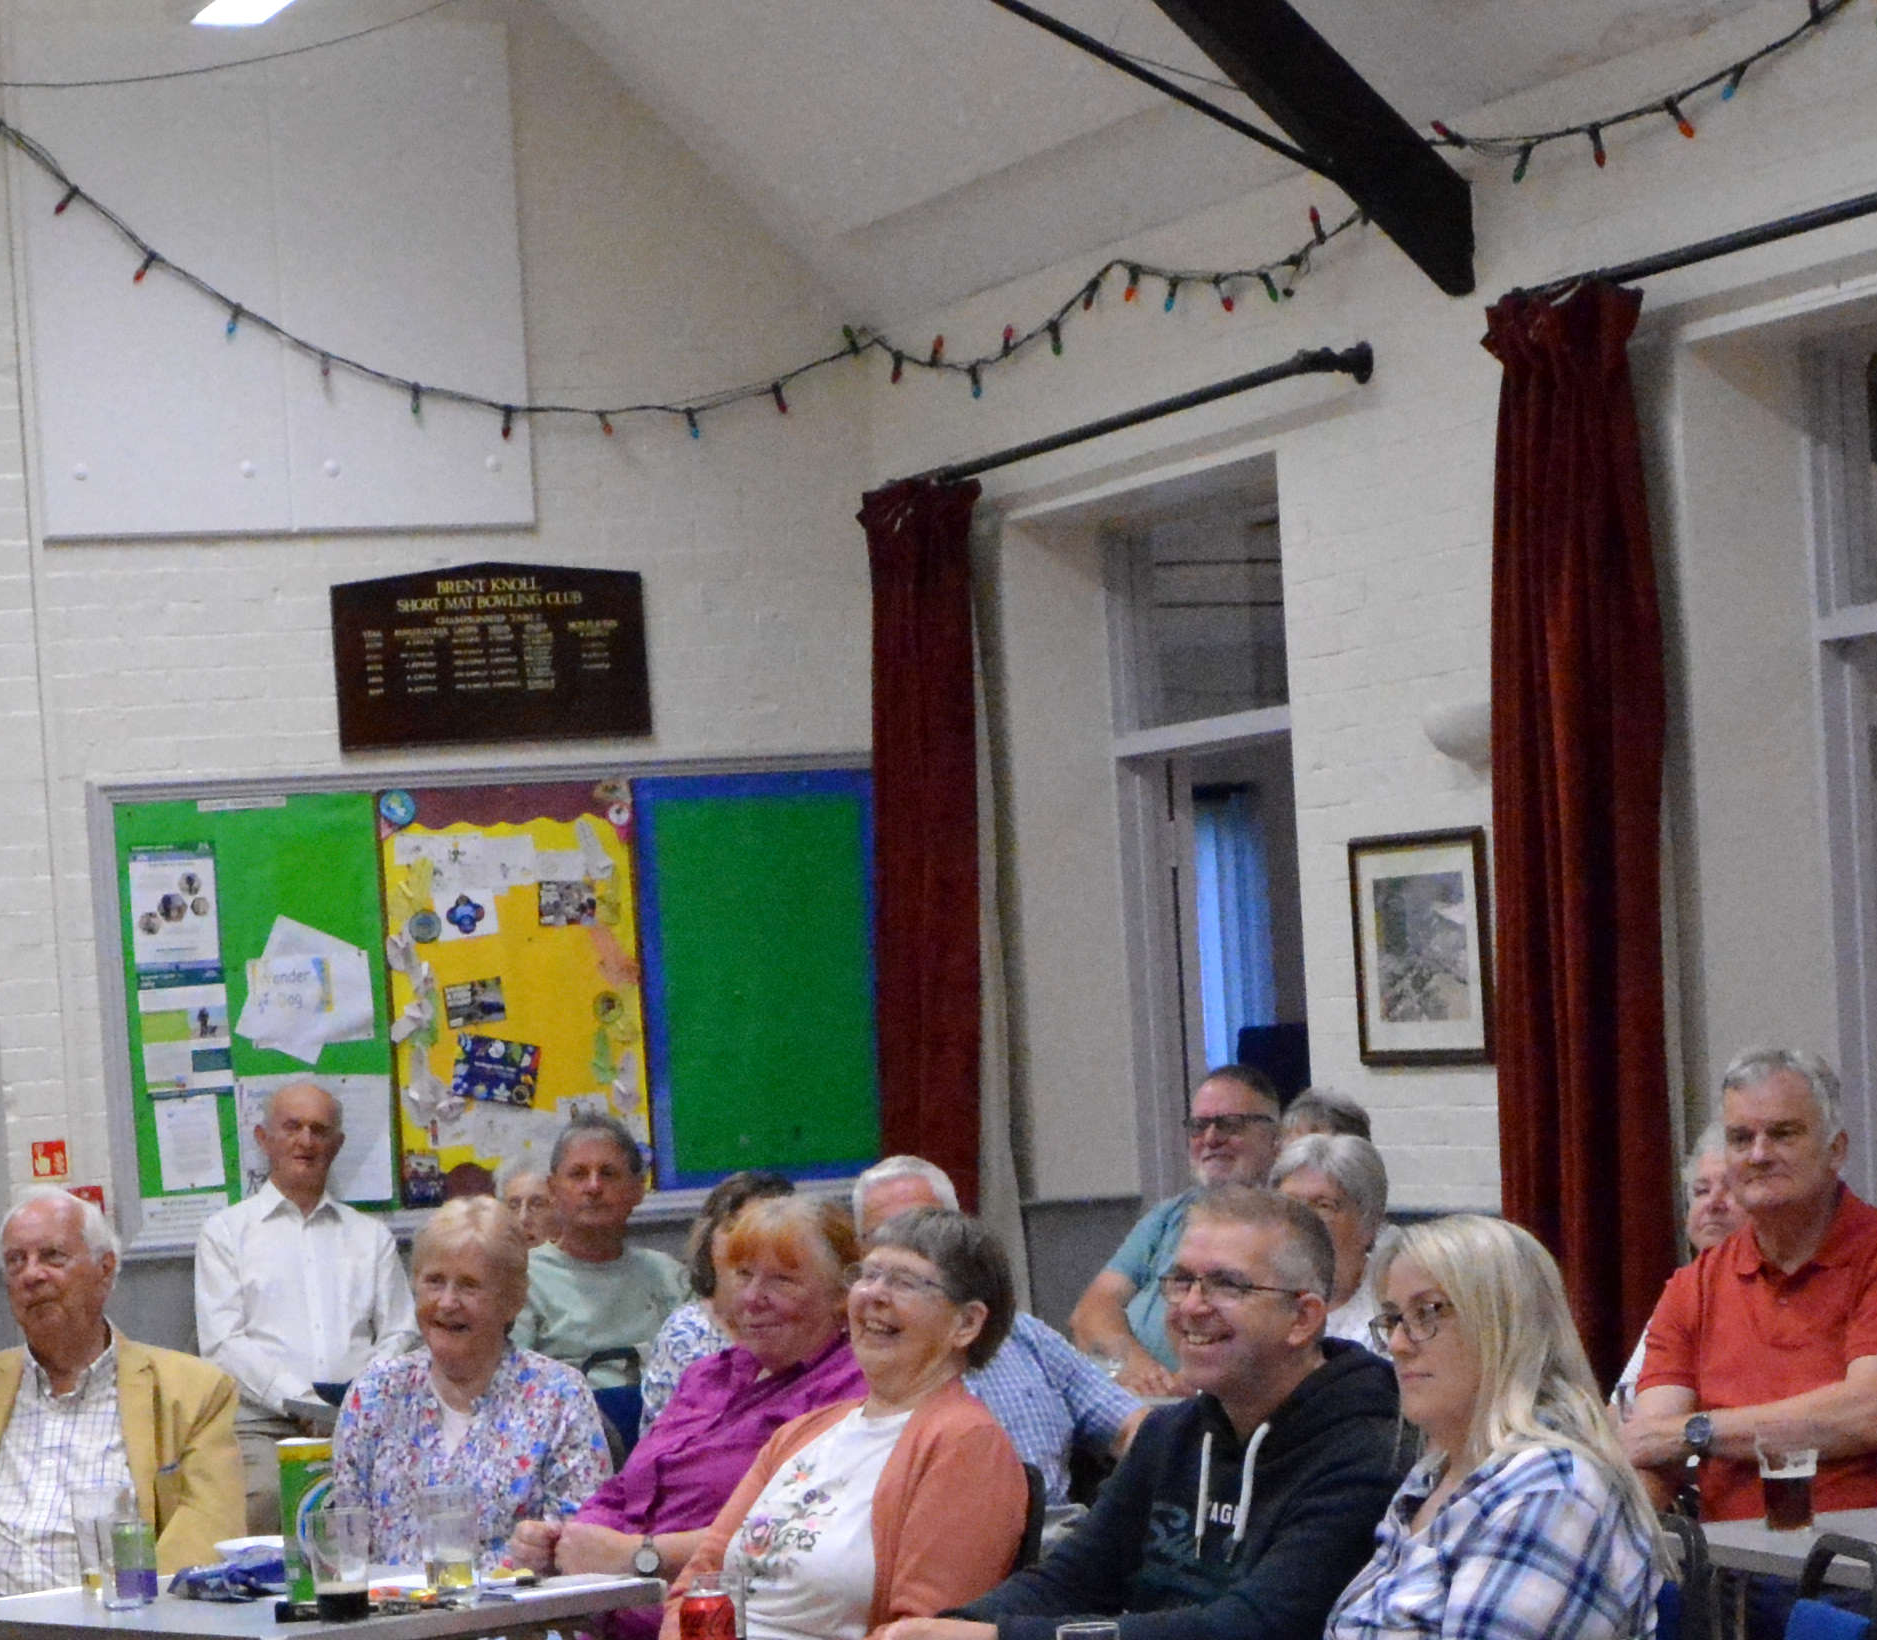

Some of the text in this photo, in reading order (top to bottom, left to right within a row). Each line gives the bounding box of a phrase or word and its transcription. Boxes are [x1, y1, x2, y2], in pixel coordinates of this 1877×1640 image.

[436, 578, 487, 594] BRENT
[396, 597, 440, 613] SHORT
[477, 592, 542, 609] BOWLING
[546, 590, 583, 605] CLUB
